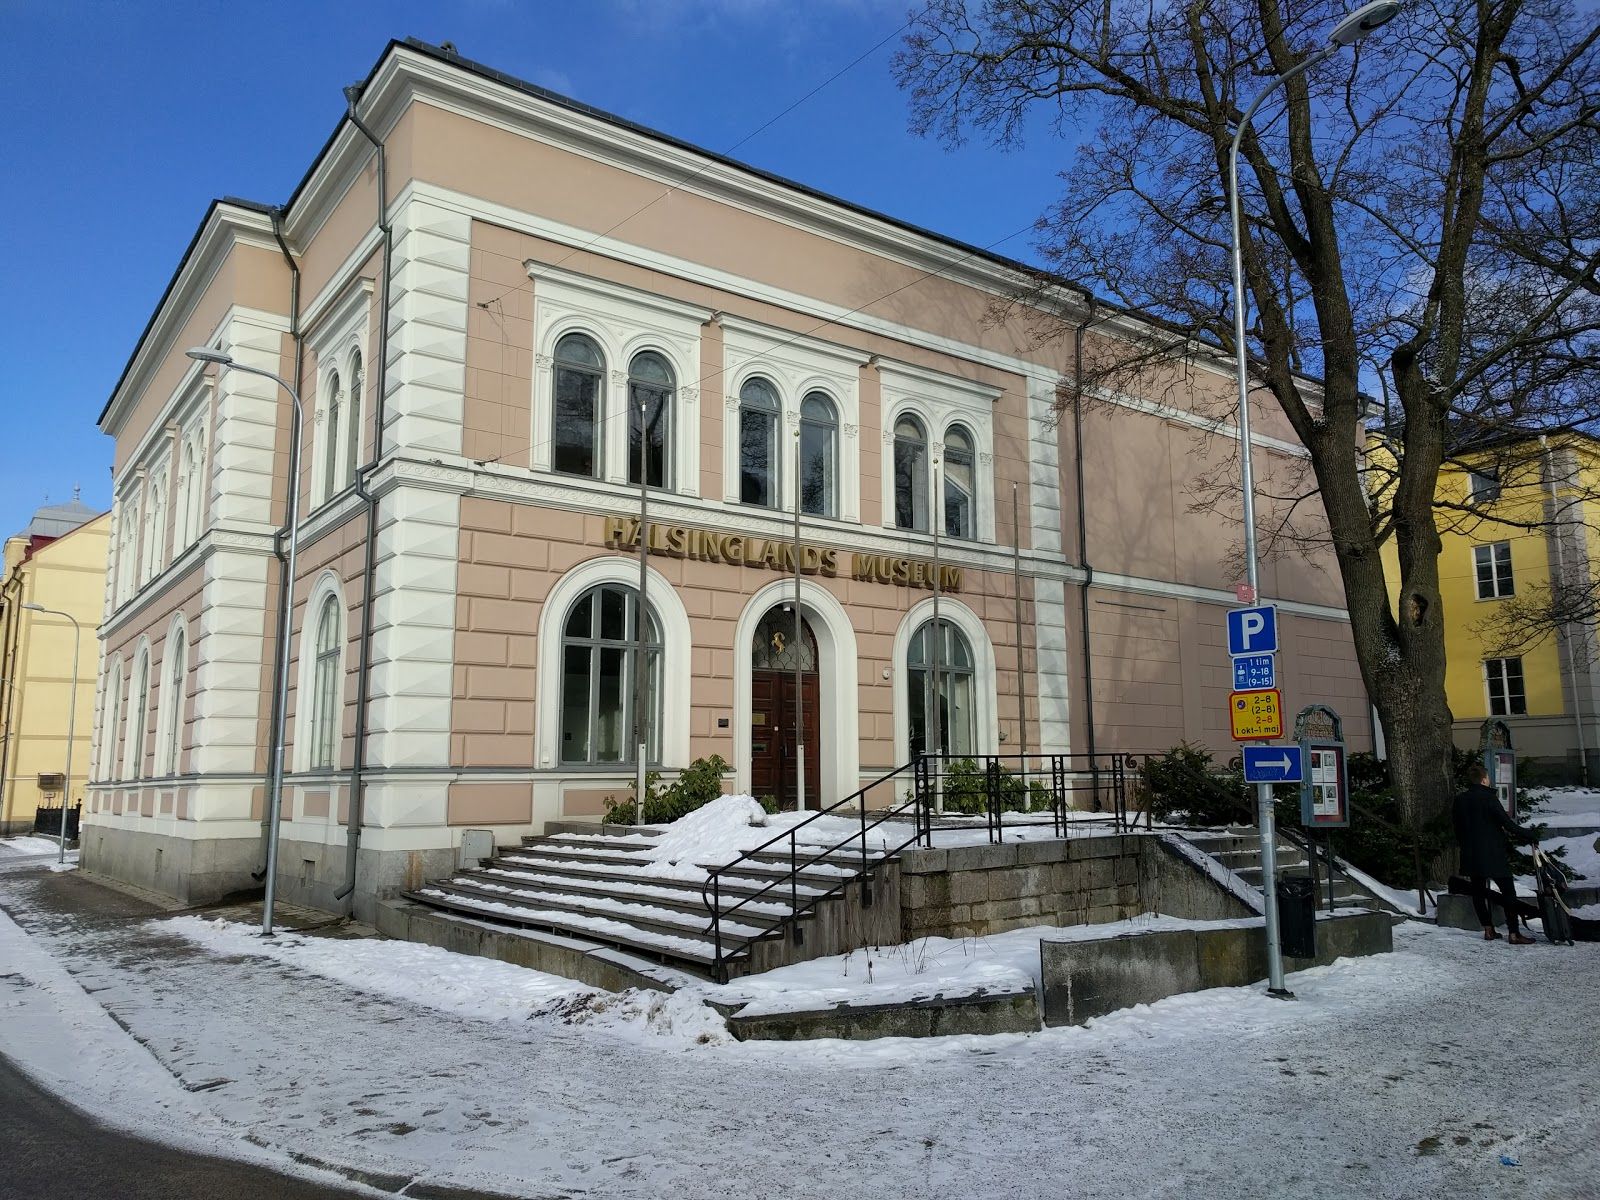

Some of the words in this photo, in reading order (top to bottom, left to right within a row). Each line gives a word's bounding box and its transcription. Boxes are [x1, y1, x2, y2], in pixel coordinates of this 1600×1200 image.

[852, 553, 964, 591] MUSEUM
[1241, 612, 1265, 650] P
[1249, 658, 1253, 666] 1
[1255, 657, 1270, 666] tim
[1250, 667, 1270, 676] 9-18
[1248, 676, 1273, 687] (9-15)
[1254, 695, 1271, 704] 2-8
[1251, 704, 1276, 715] (2-8)
[1256, 715, 1273, 724] 2-8
[1264, 725, 1279, 734] maj
